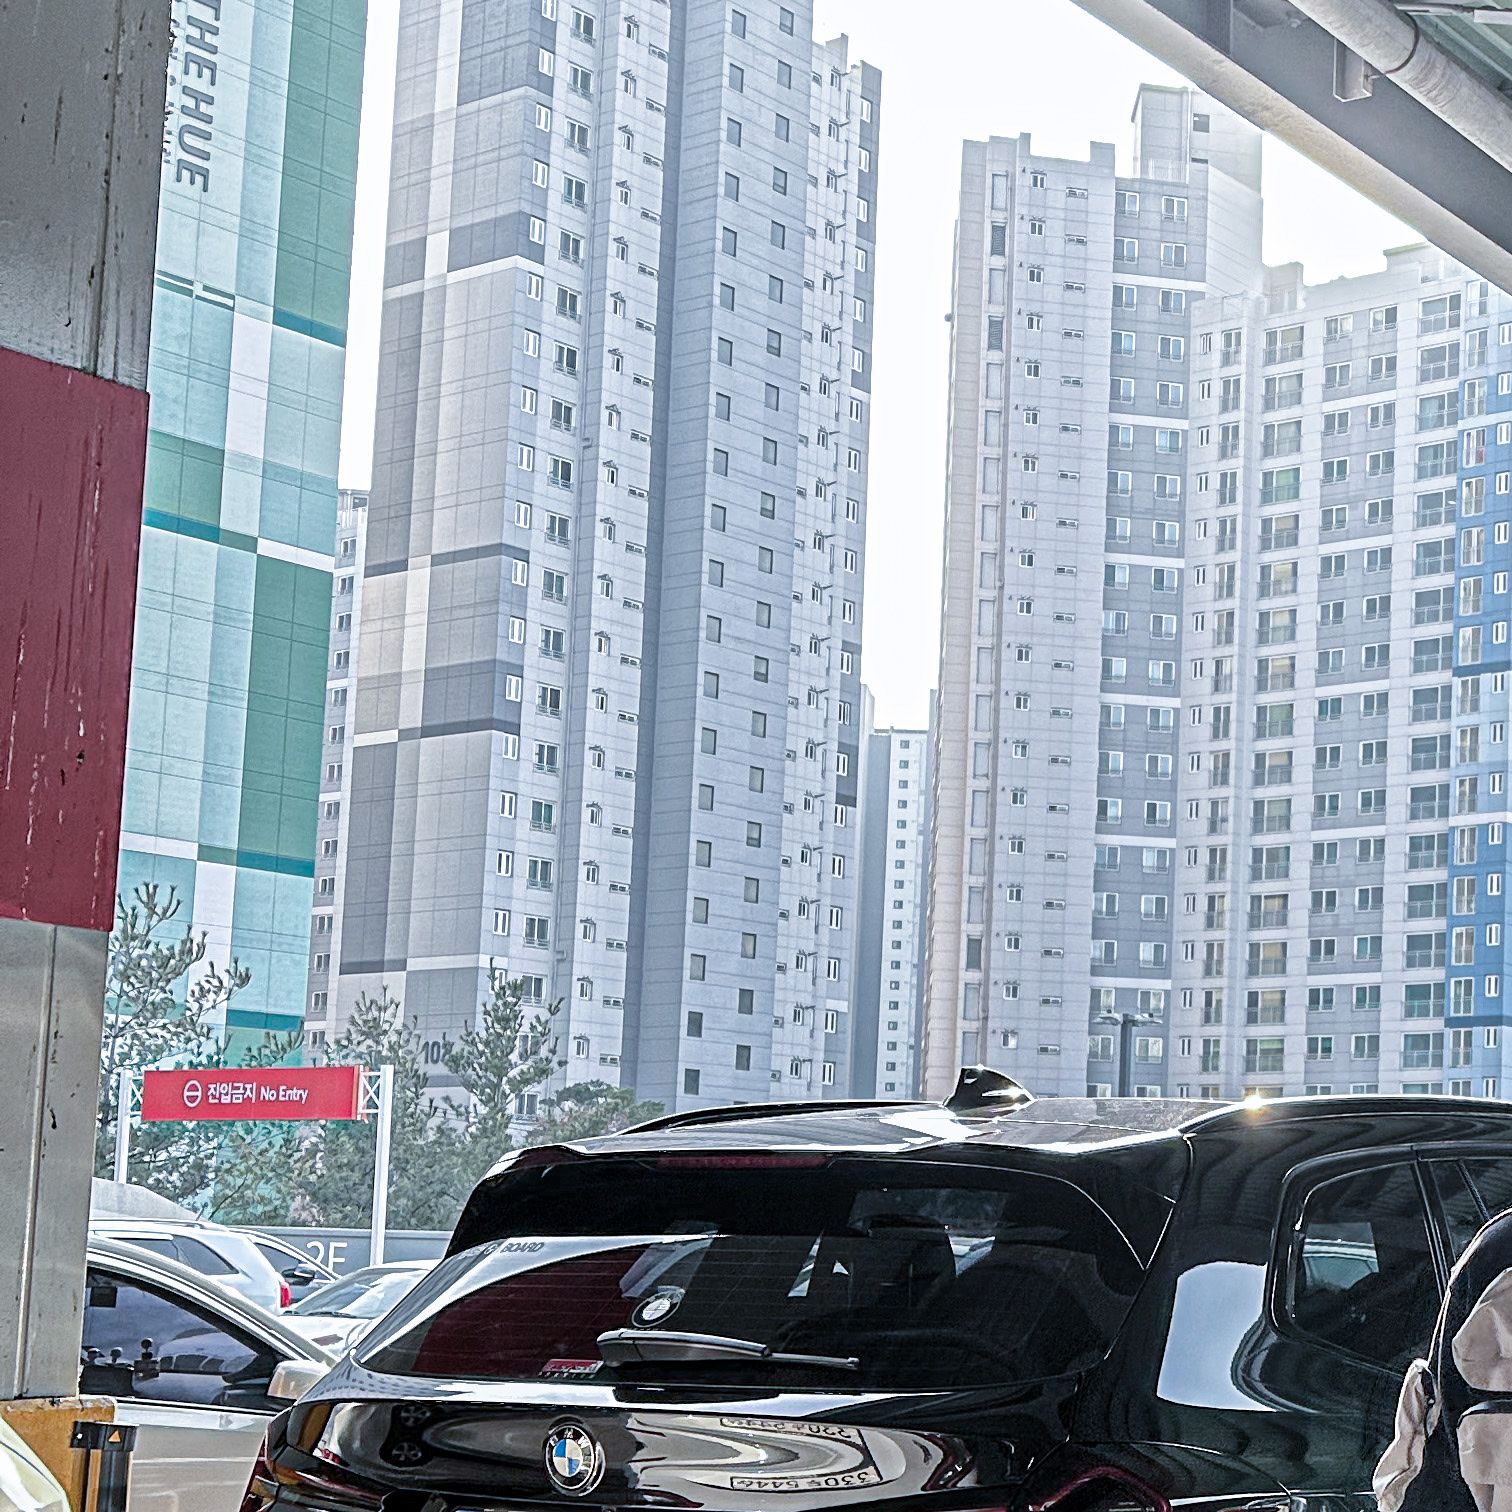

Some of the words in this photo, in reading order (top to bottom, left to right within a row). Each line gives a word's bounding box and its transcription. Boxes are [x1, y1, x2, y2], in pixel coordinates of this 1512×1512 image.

[421, 1041, 448, 1065] 10
[207, 1082, 257, 1104] 진입금지
[260, 1085, 277, 1101] No
[278, 1085, 308, 1105] Entry
